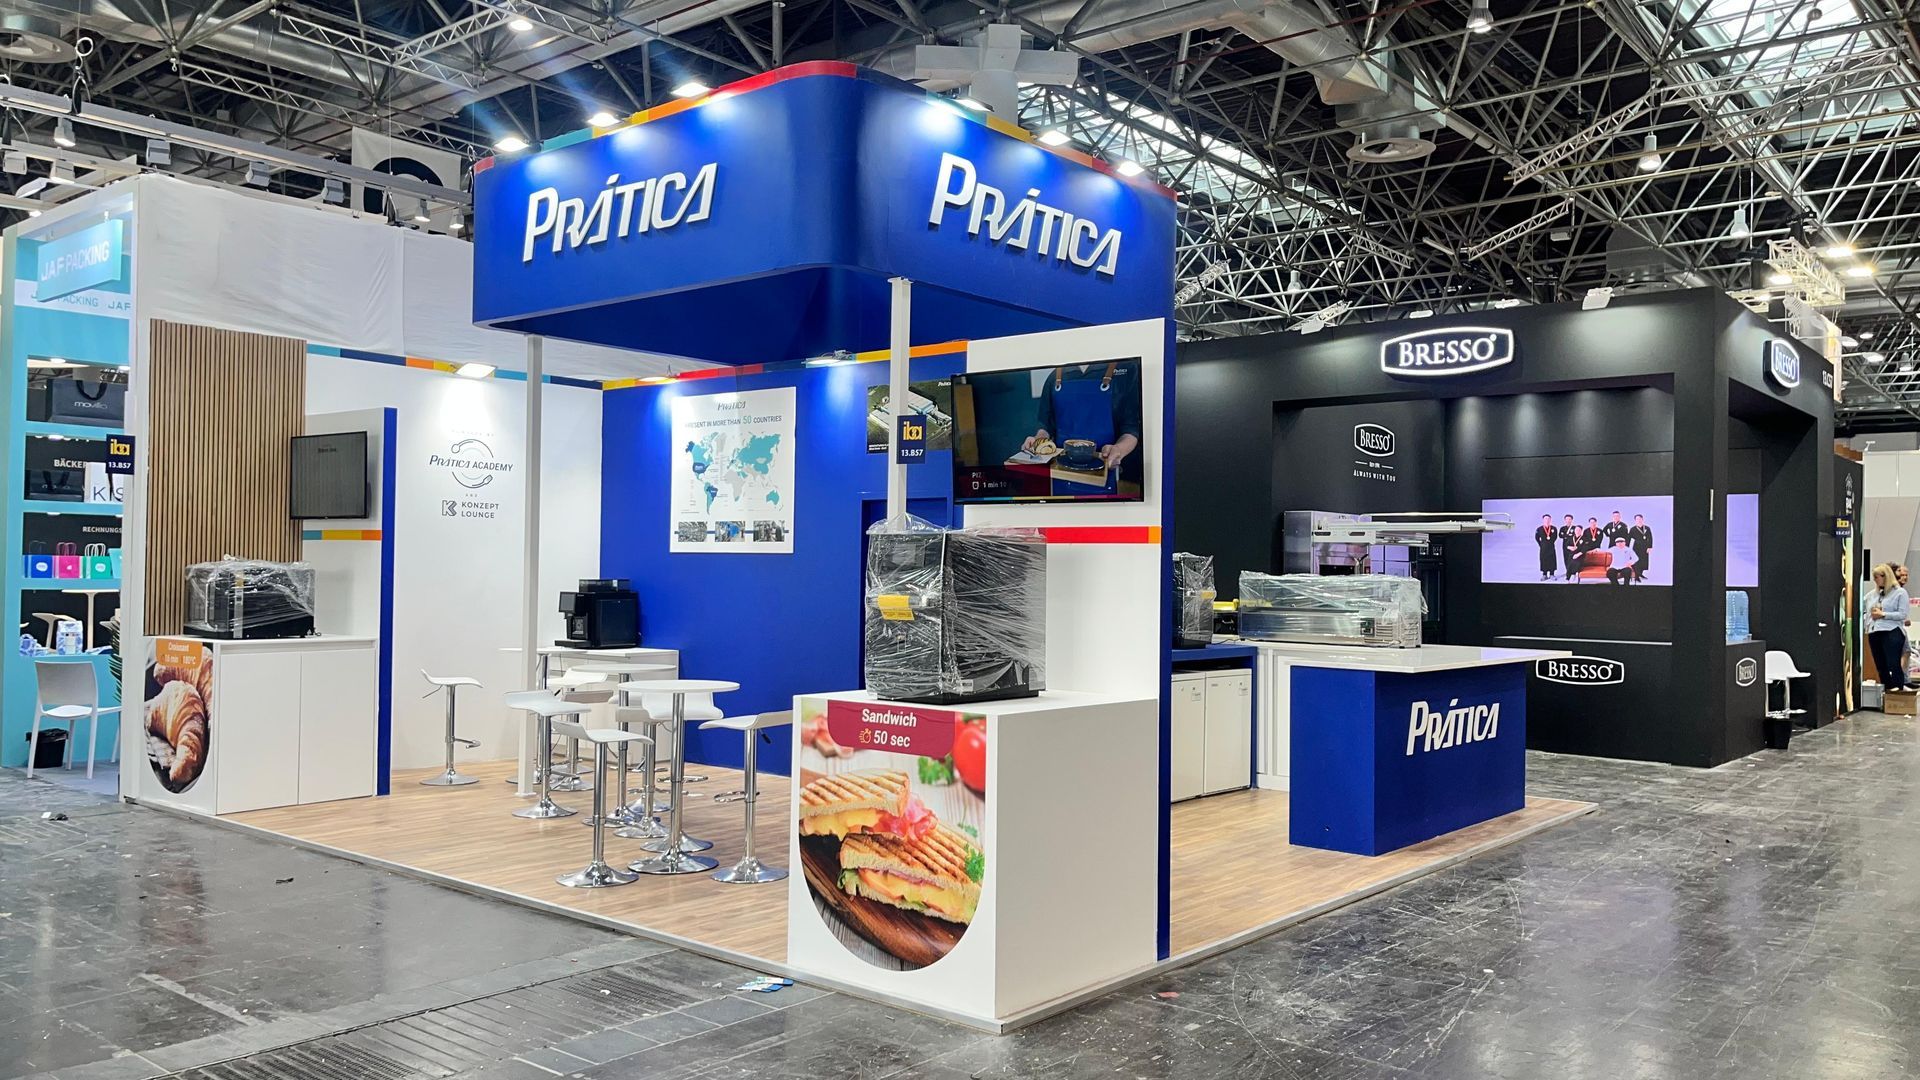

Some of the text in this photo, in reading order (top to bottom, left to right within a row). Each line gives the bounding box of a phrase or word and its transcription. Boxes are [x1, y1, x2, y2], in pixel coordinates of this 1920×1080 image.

[523, 162, 718, 263] PRÁTICA
[929, 151, 1122, 276] PRÁTICA
[41, 241, 110, 281] JAF PACKING
[107, 301, 131, 311] JAF
[1398, 337, 1494, 367] BRESSO
[713, 419, 726, 427] MORE
[743, 416, 752, 424] 50
[753, 415, 782, 424] COUNTRIES
[1360, 428, 1390, 451] BRESSO
[472, 461, 513, 471] ACADEMY
[461, 501, 499, 510] KONZEPT
[461, 510, 495, 518] LOUNGE
[1548, 661, 1612, 680] BRESSO
[862, 708, 917, 728] Sandwich
[1406, 698, 1500, 756] PRÁTICA
[873, 730, 911, 748] 50 sec
